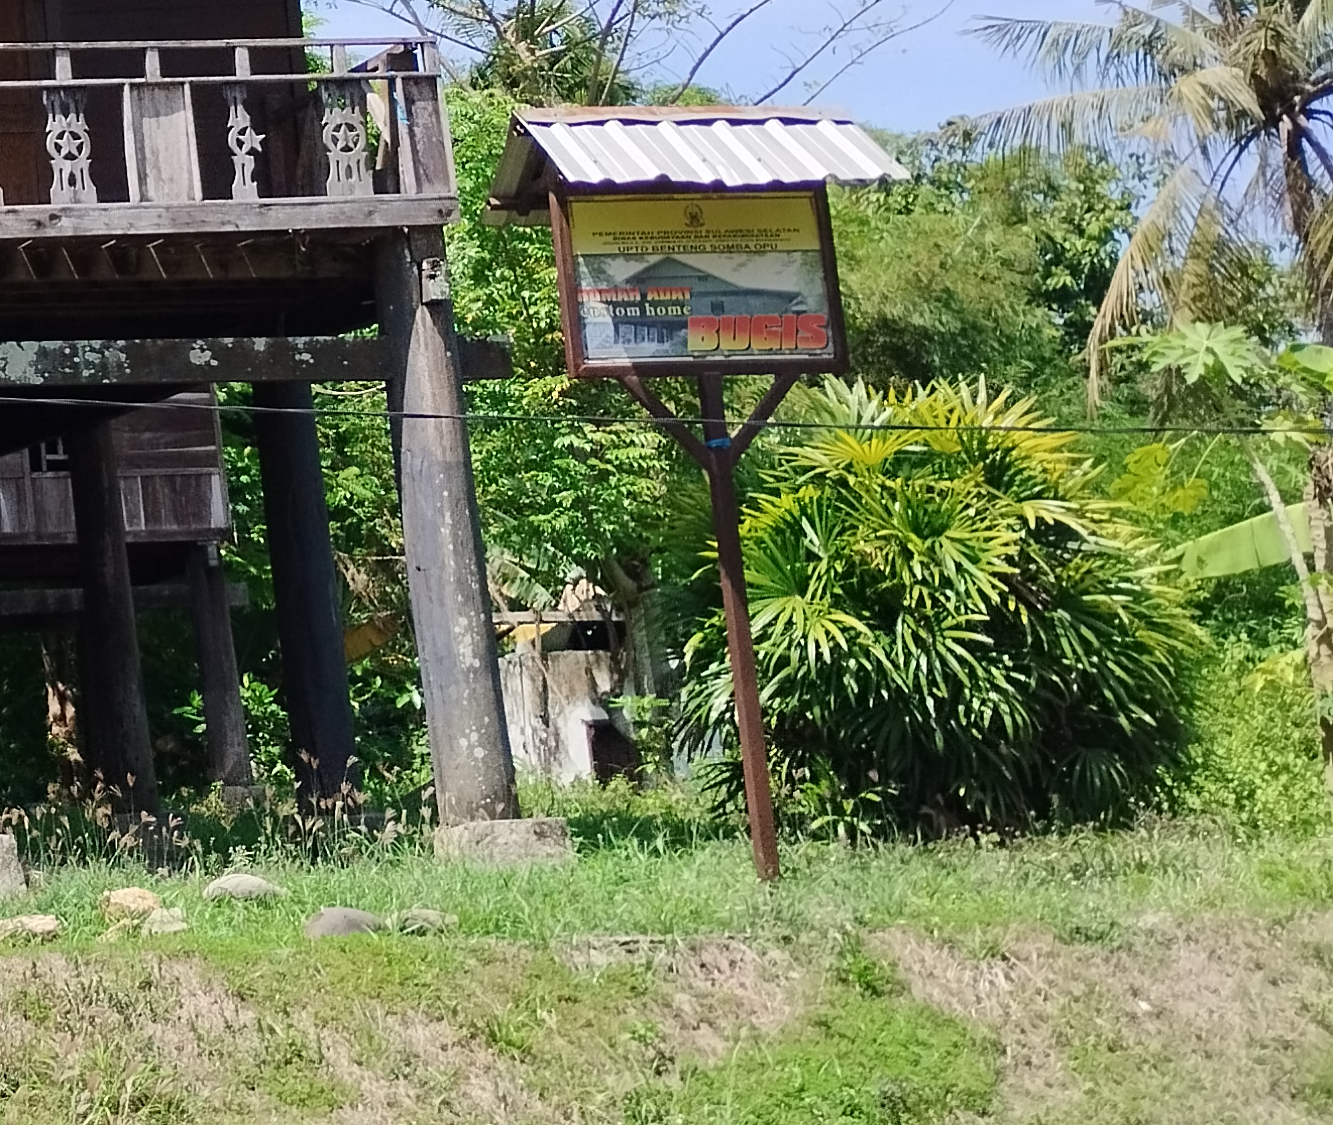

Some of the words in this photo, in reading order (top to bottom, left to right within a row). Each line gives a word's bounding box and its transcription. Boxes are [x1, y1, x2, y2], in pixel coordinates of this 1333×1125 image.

[577, 288, 641, 302] RUMAH
[647, 286, 692, 301] ADAT
[579, 305, 641, 318] custom
[645, 302, 693, 316] home
[687, 314, 829, 351] BUGIS
